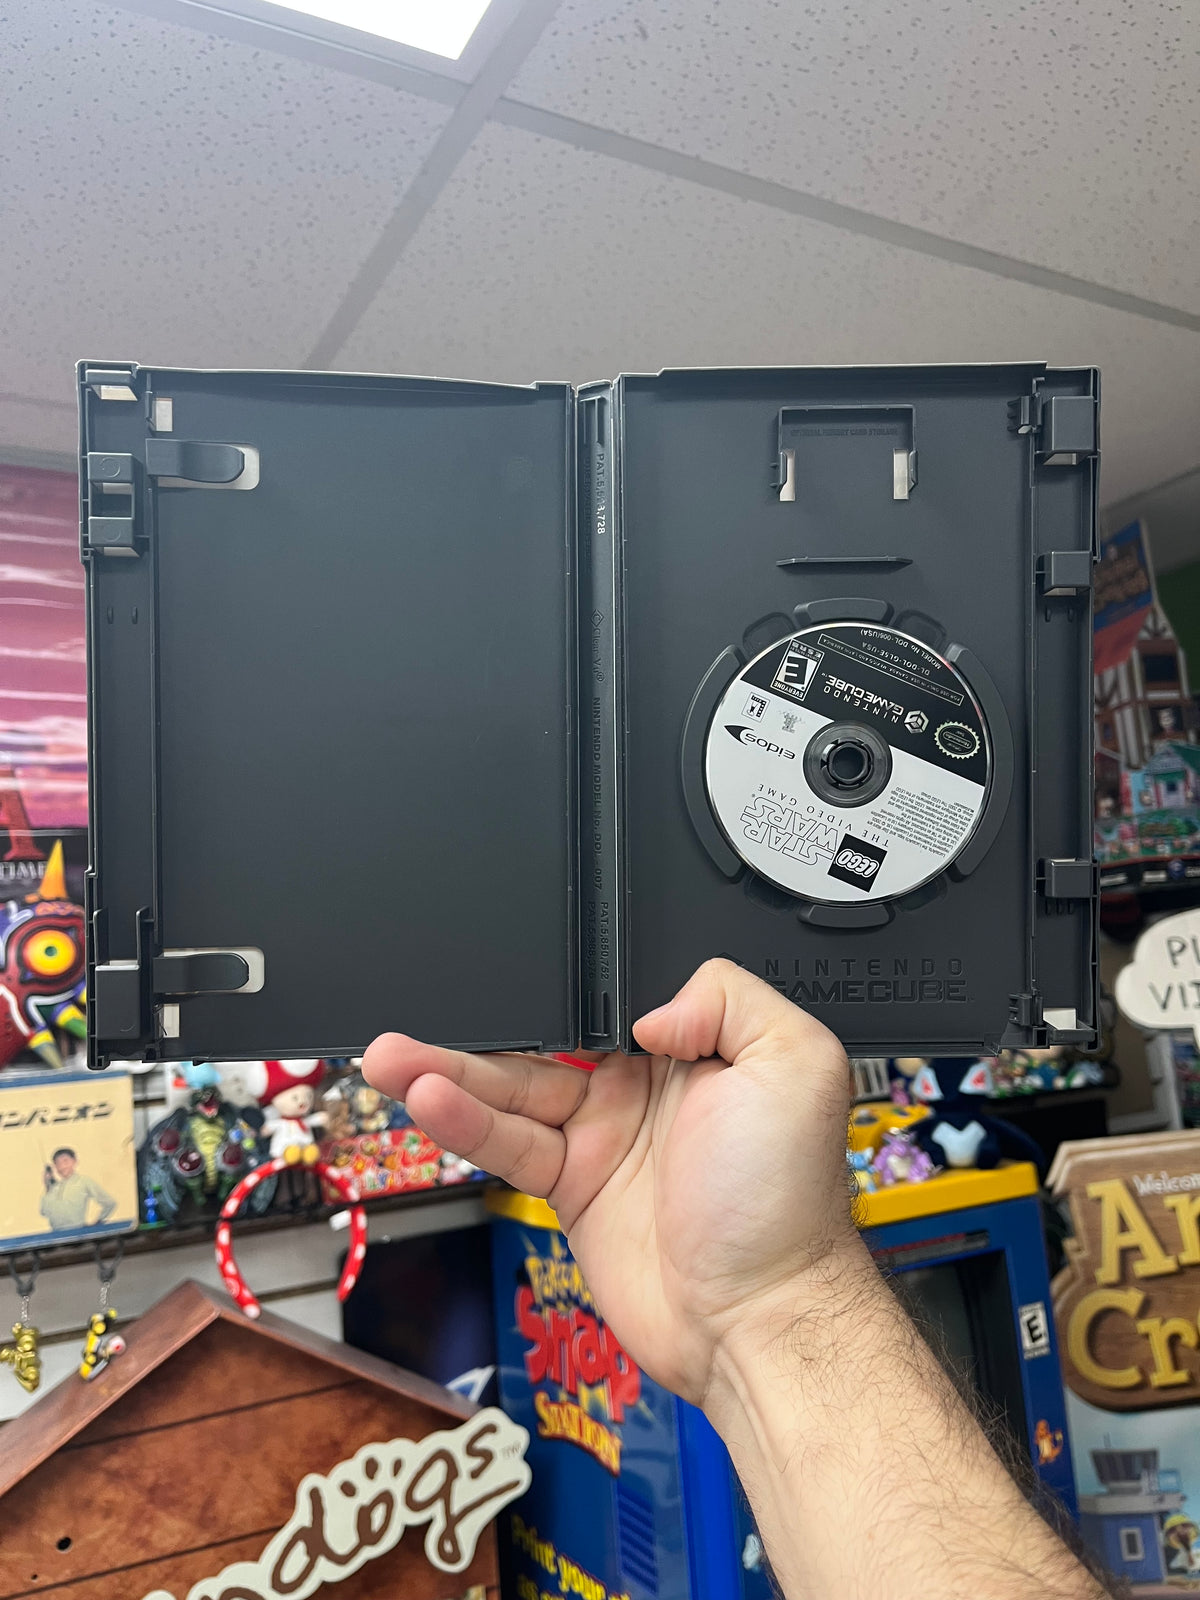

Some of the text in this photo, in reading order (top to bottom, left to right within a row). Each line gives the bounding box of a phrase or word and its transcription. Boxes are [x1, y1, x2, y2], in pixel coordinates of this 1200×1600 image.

[784, 656, 807, 684] E
[773, 679, 803, 697] EVERYONE
[823, 686, 899, 723] NINTENDO
[826, 675, 904, 716] GAMECUBE
[593, 697, 602, 762] NINTENDO
[744, 733, 796, 760] eidos
[743, 796, 838, 851] WARS
[757, 783, 889, 846] THE VIDEO GAME
[739, 812, 834, 865] STAR
[833, 848, 879, 878] LEGO
[765, 958, 963, 977] NINTENDO
[0, 1101, 113, 1128] ンパニオン
